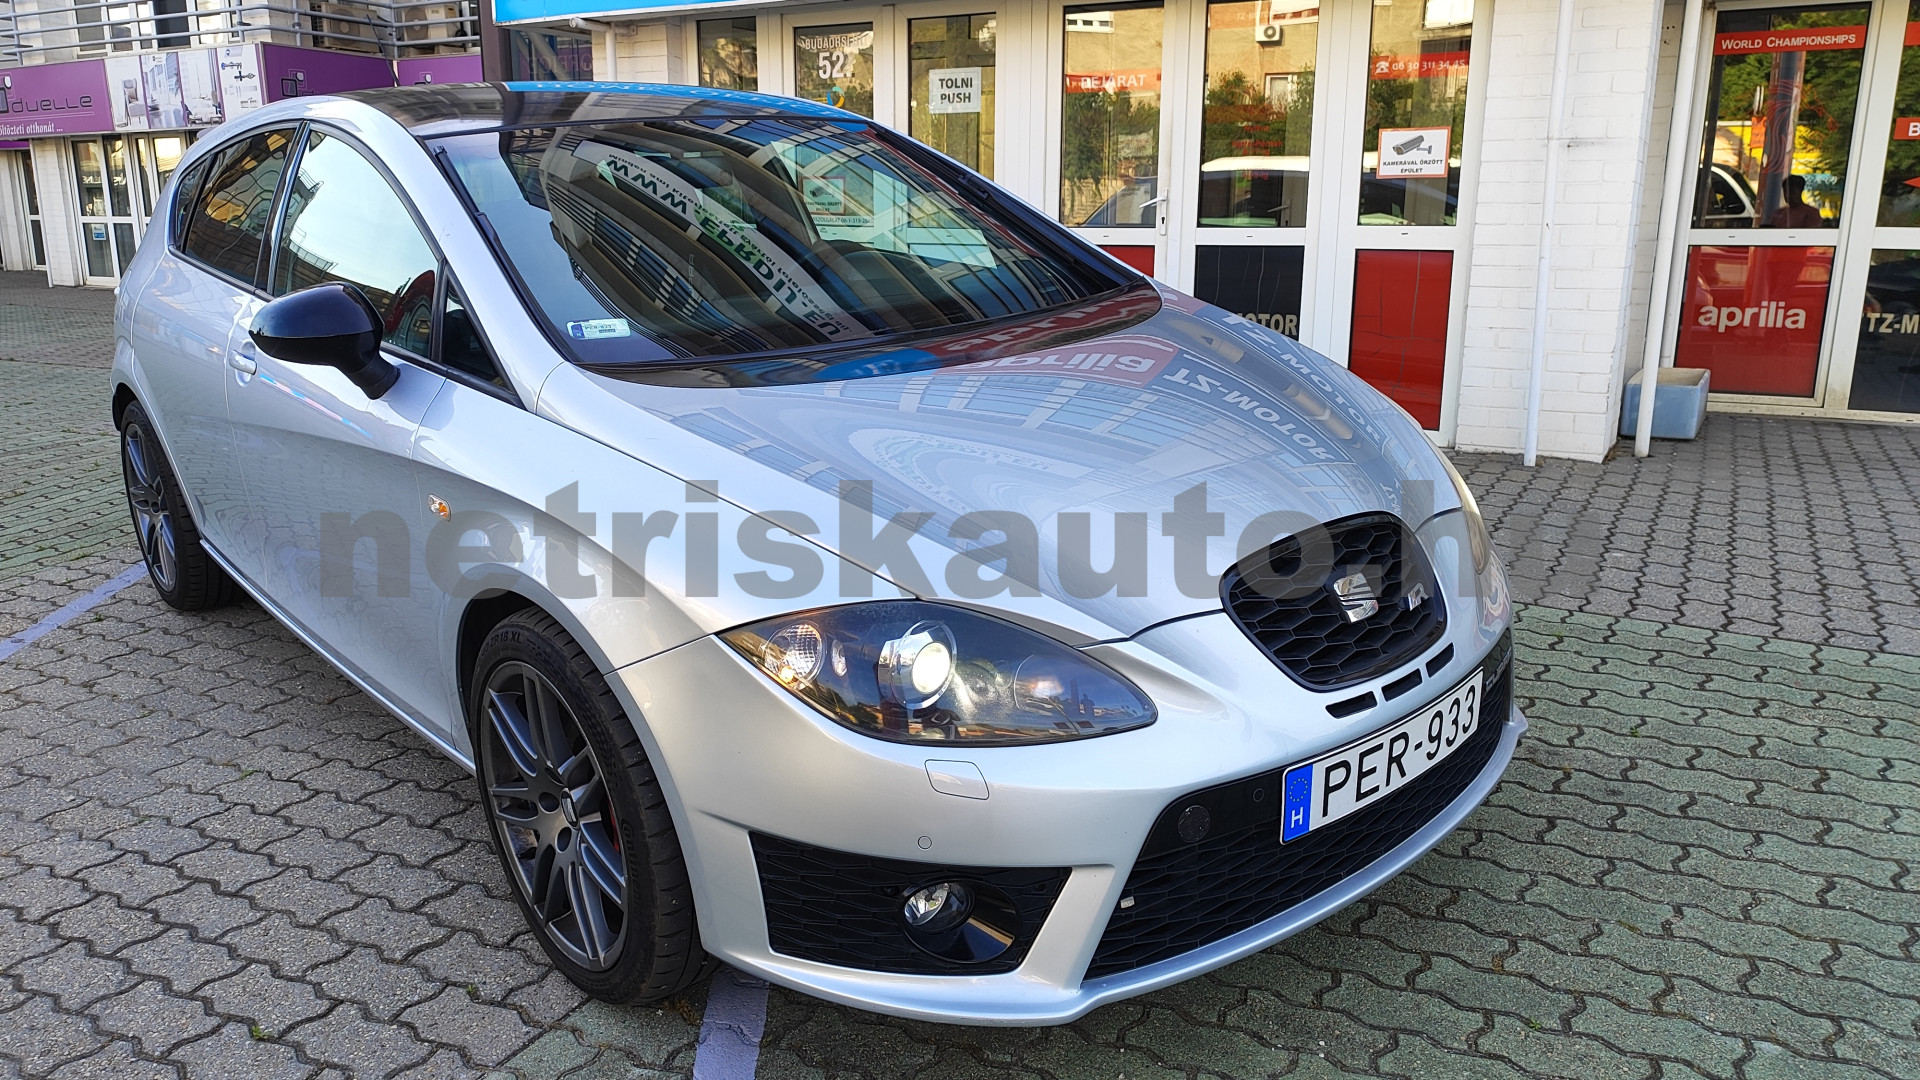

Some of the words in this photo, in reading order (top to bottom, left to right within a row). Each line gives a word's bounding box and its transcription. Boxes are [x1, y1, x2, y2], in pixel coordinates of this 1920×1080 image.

[1721, 39, 1762, 50] WORLD
[1767, 34, 1856, 47] CHAMPIONSHIPS
[1392, 61, 1405, 71] 06
[1407, 61, 1420, 72] 30
[1421, 61, 1435, 71] 311
[1437, 60, 1450, 71] 34
[1453, 59, 1466, 70] 45
[938, 77, 973, 89] TOLNI
[1080, 73, 1147, 89] BEJÁRAT
[940, 92, 971, 104] PUSH
[1237, 313, 1298, 336] TOR
[1697, 301, 1807, 333] aprilia
[1321, 683, 1477, 818] PER-933
[1290, 806, 1304, 829] H
